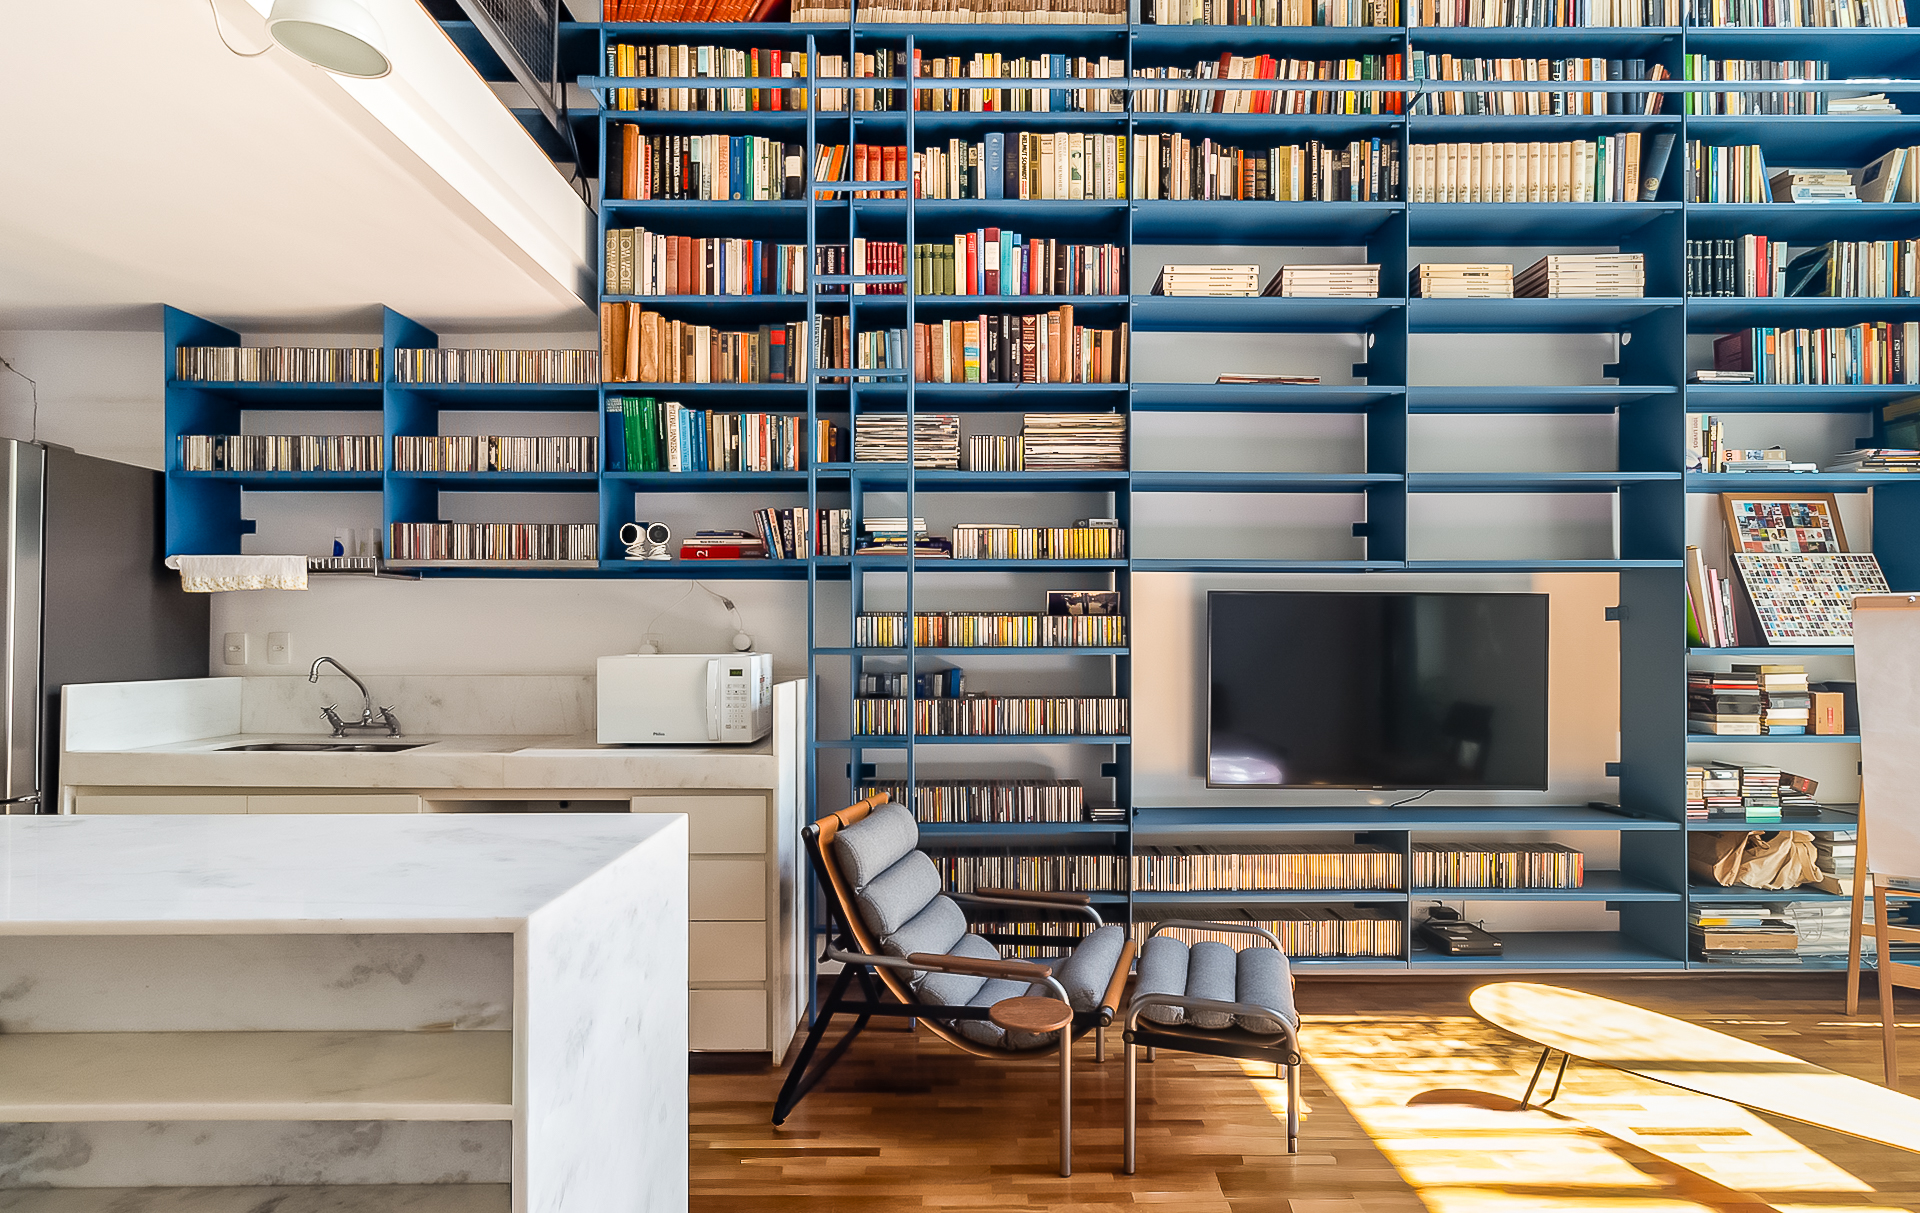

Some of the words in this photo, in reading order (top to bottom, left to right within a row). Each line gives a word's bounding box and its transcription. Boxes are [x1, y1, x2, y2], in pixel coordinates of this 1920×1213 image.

[606, 236, 617, 259] TOM
[620, 235, 632, 258] TOM
[606, 261, 617, 289] WOLFE
[620, 260, 632, 289] WOLFE
